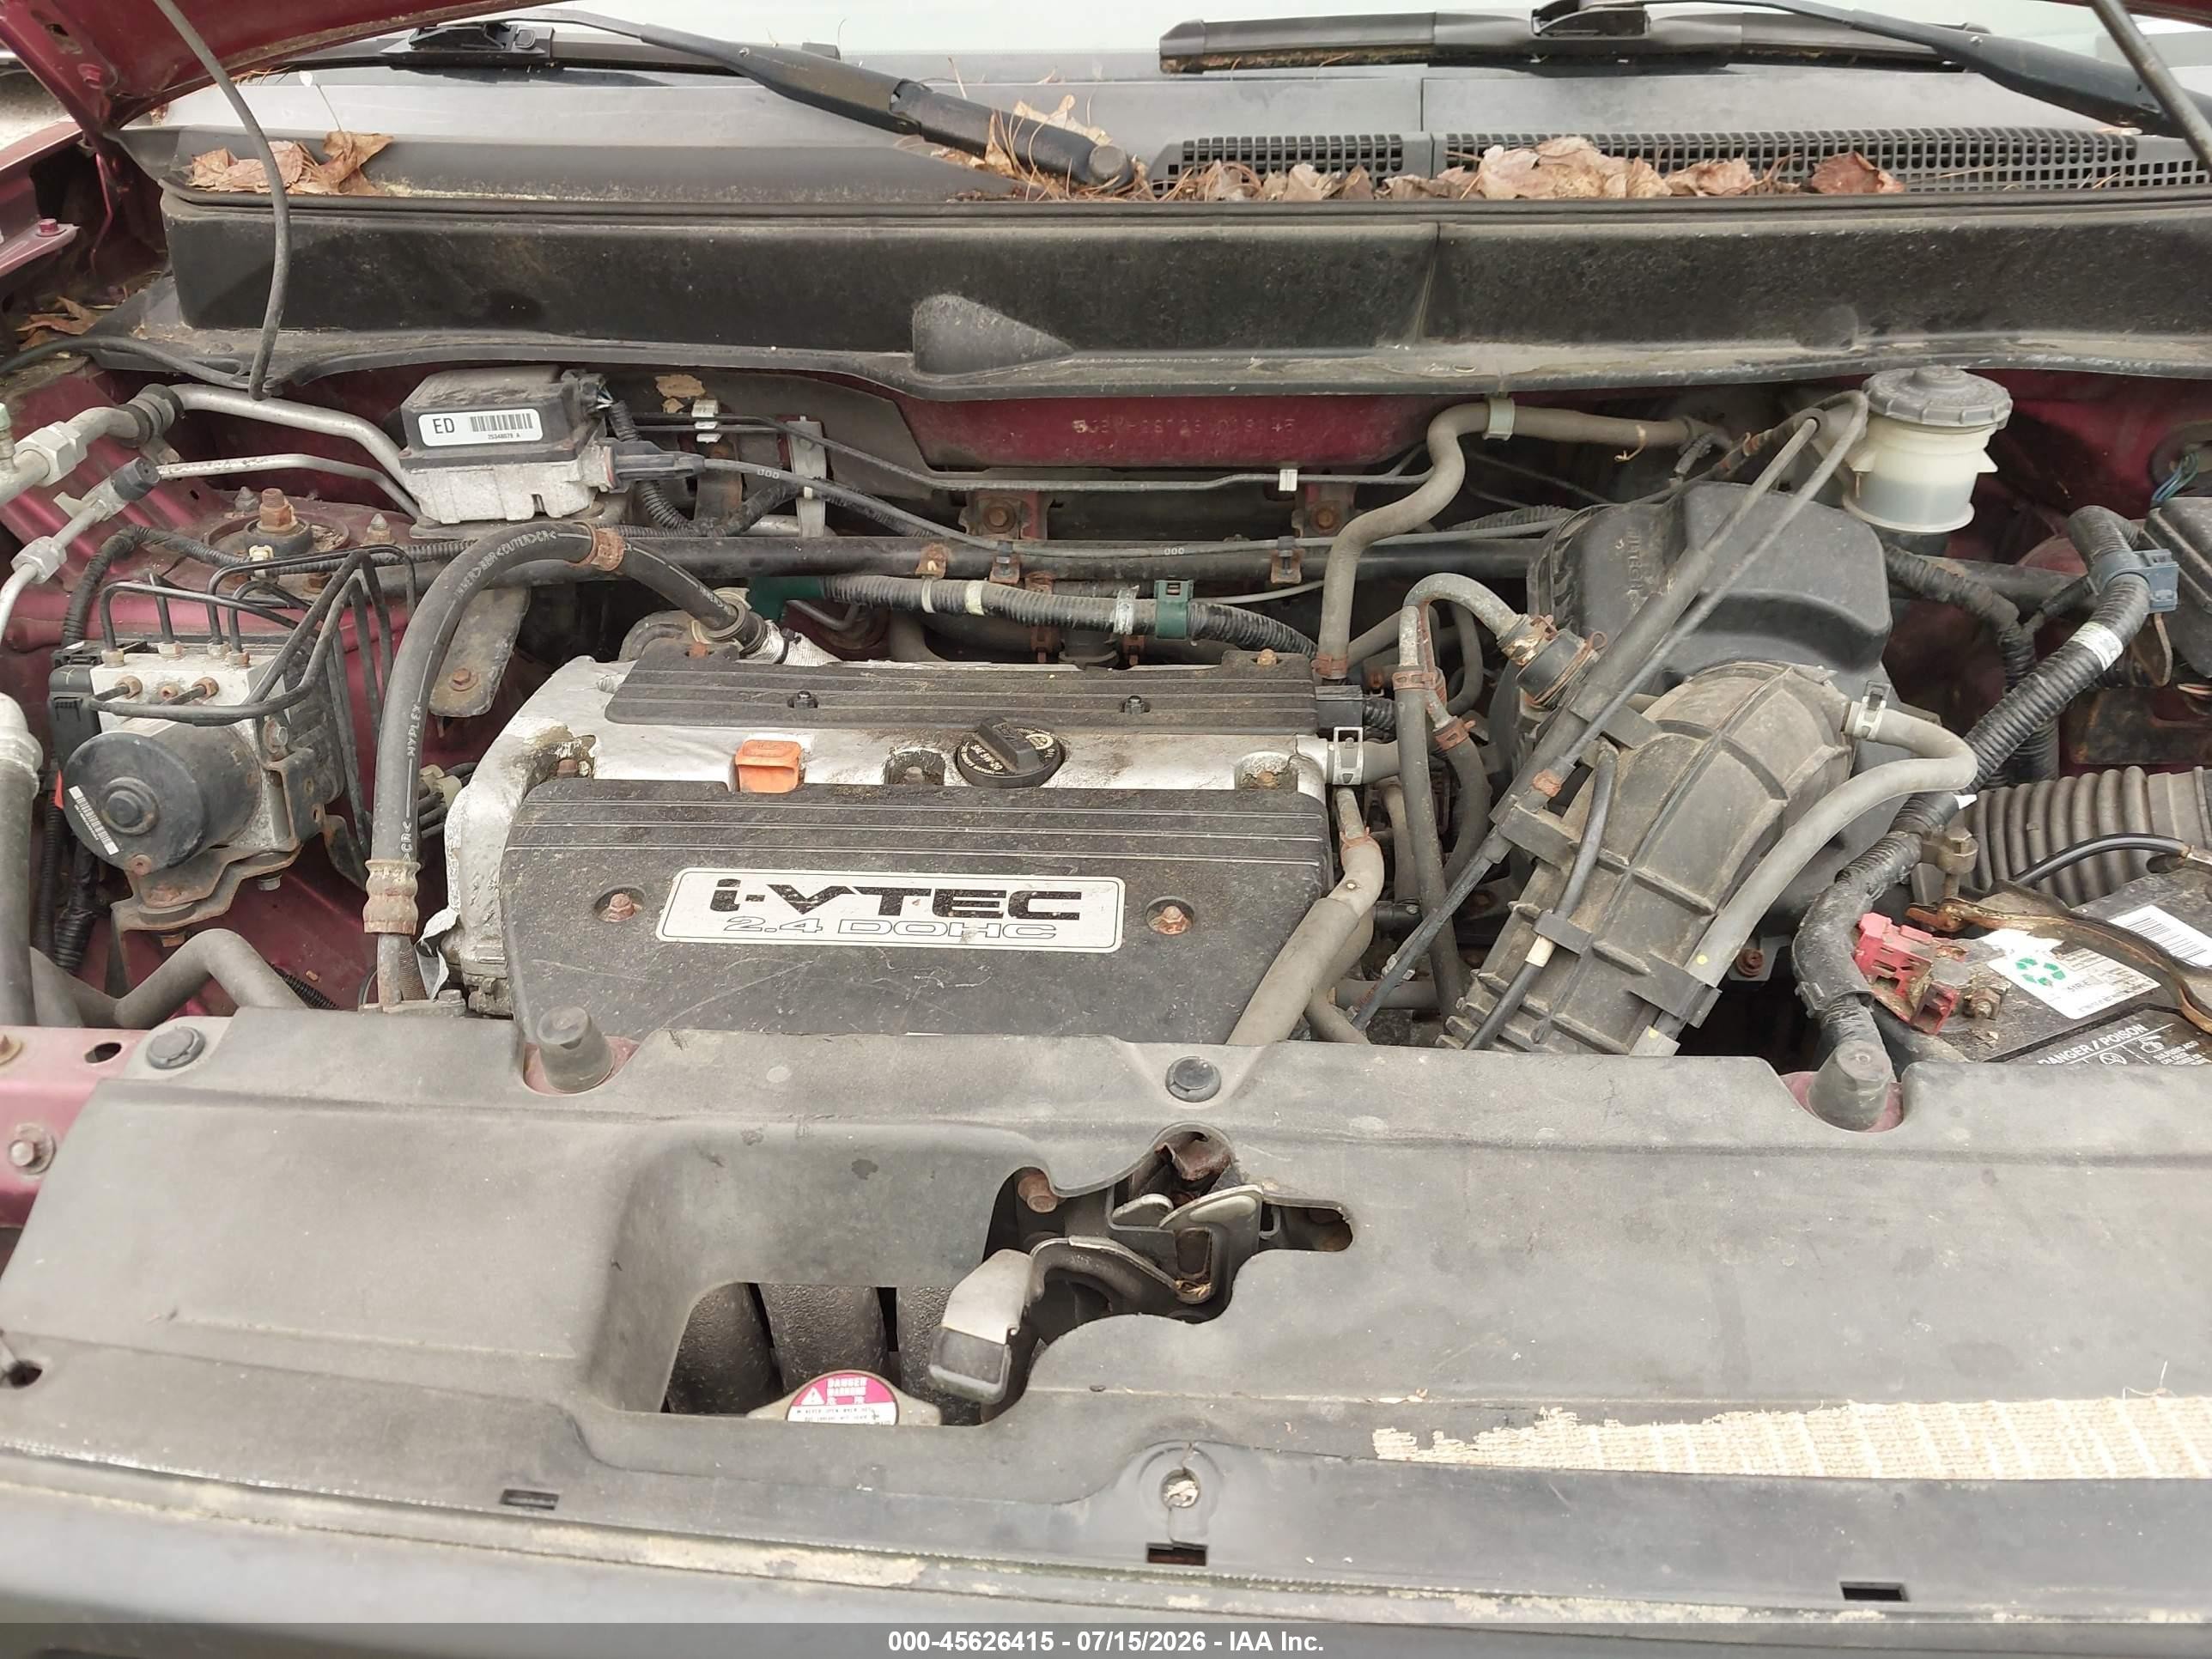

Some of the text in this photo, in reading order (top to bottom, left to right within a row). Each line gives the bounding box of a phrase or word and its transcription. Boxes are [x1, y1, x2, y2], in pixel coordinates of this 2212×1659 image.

[433, 417, 455, 434] ED
[970, 744, 985, 754] SAE
[709, 878, 1082, 921] i-VTEC
[723, 915, 1057, 940] 2.4 DOHC
